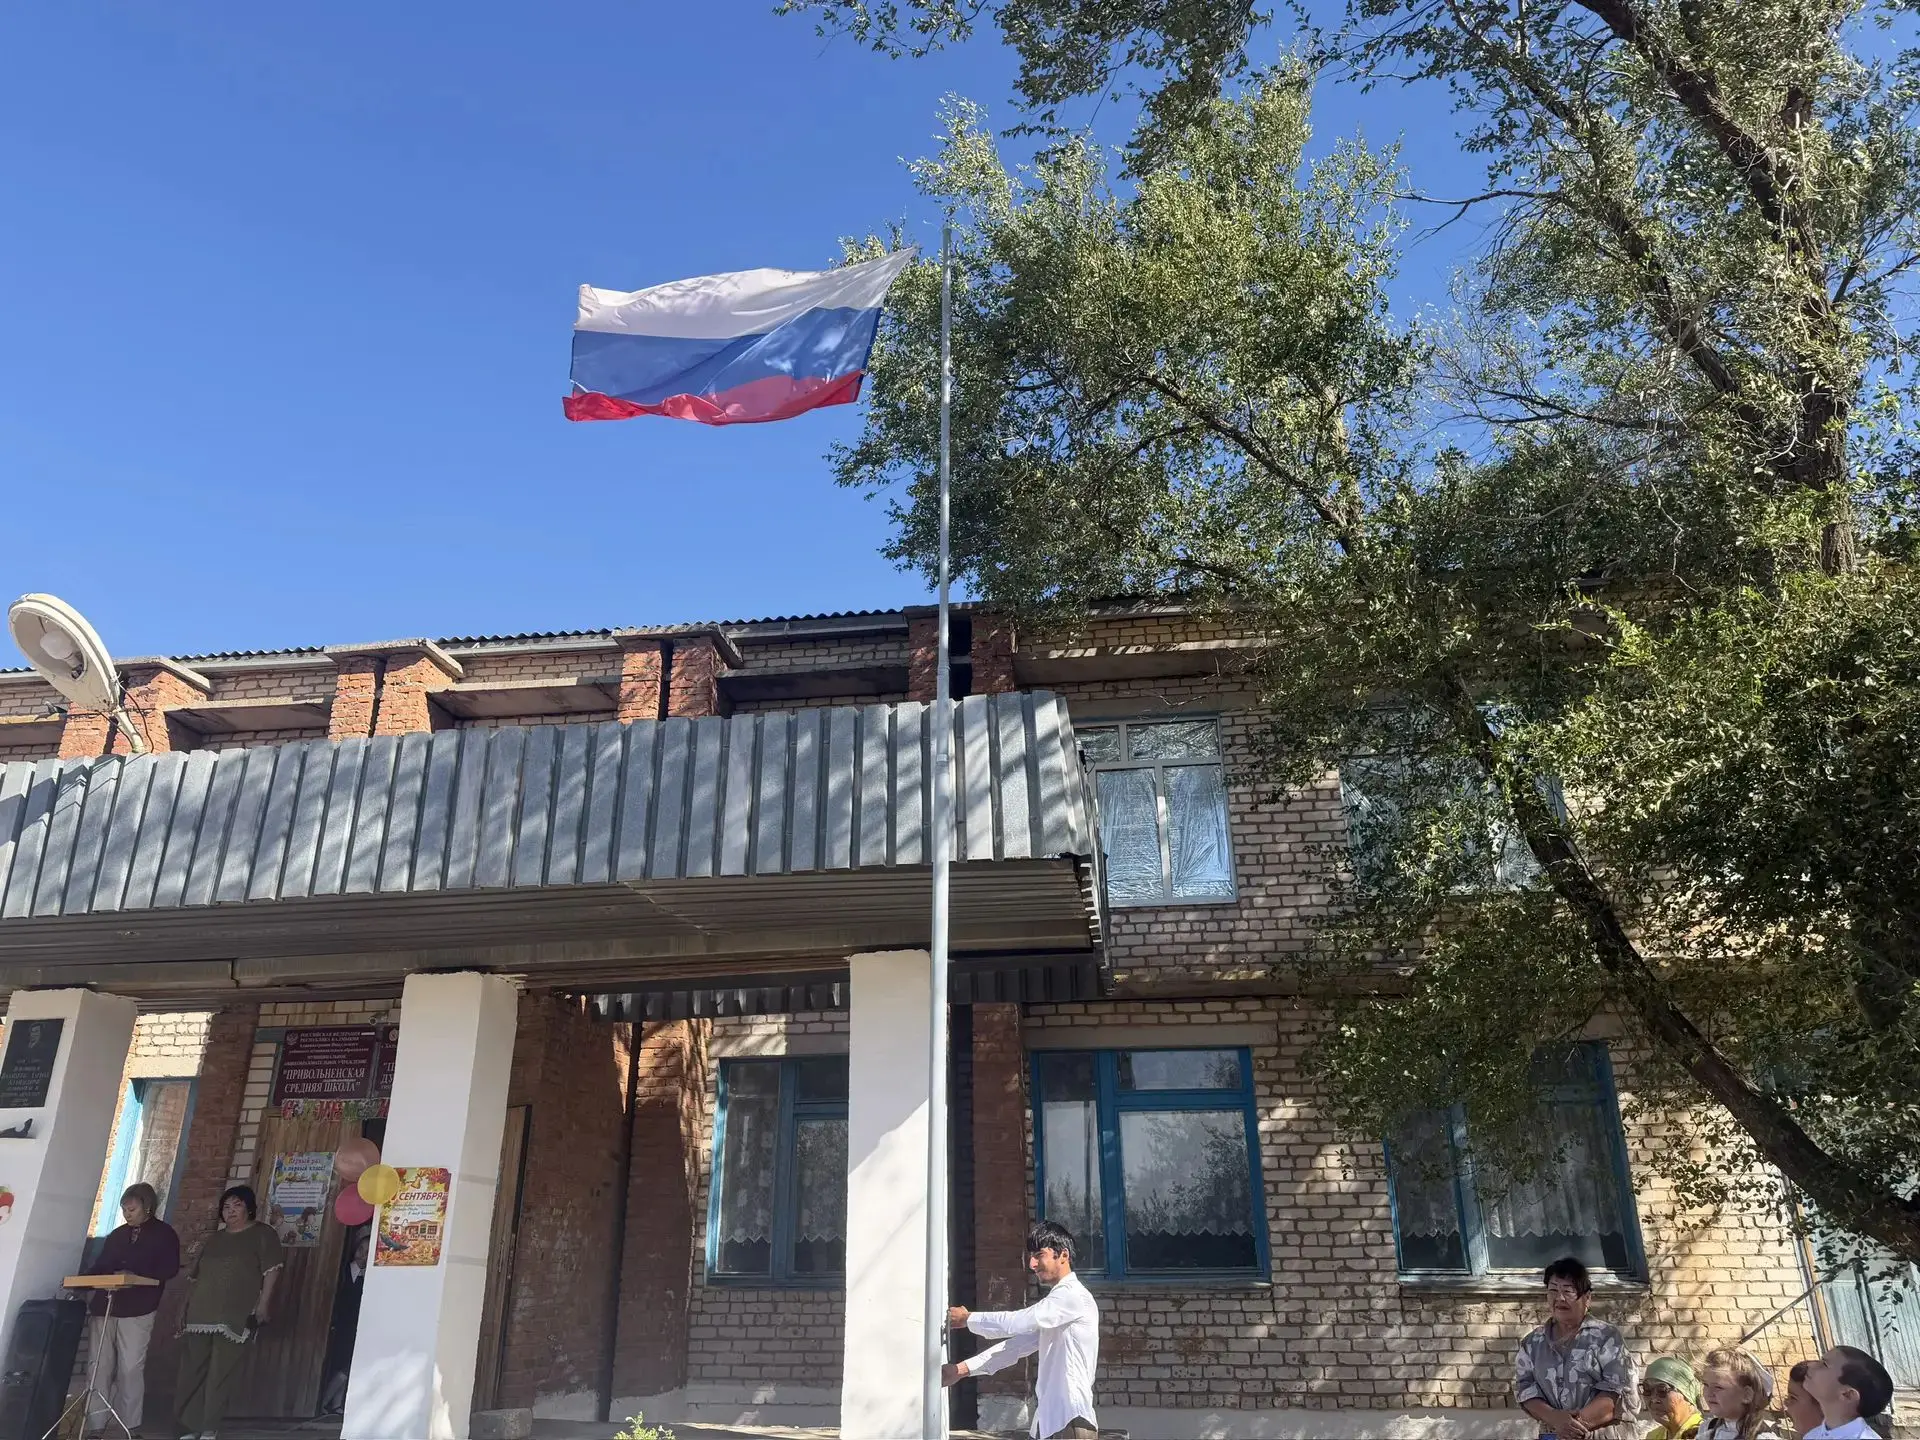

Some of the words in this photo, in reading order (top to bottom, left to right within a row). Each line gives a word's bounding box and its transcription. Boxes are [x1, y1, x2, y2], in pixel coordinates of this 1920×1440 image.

[283, 1067, 366, 1080] "ПРИВОЛЬНЕНСКАЯ
[284, 1082, 323, 1093] СРЕДНЯЯ
[323, 1081, 360, 1092] ШКОЛА"
[399, 1191, 444, 1201] СЕНТЯБРЯ
